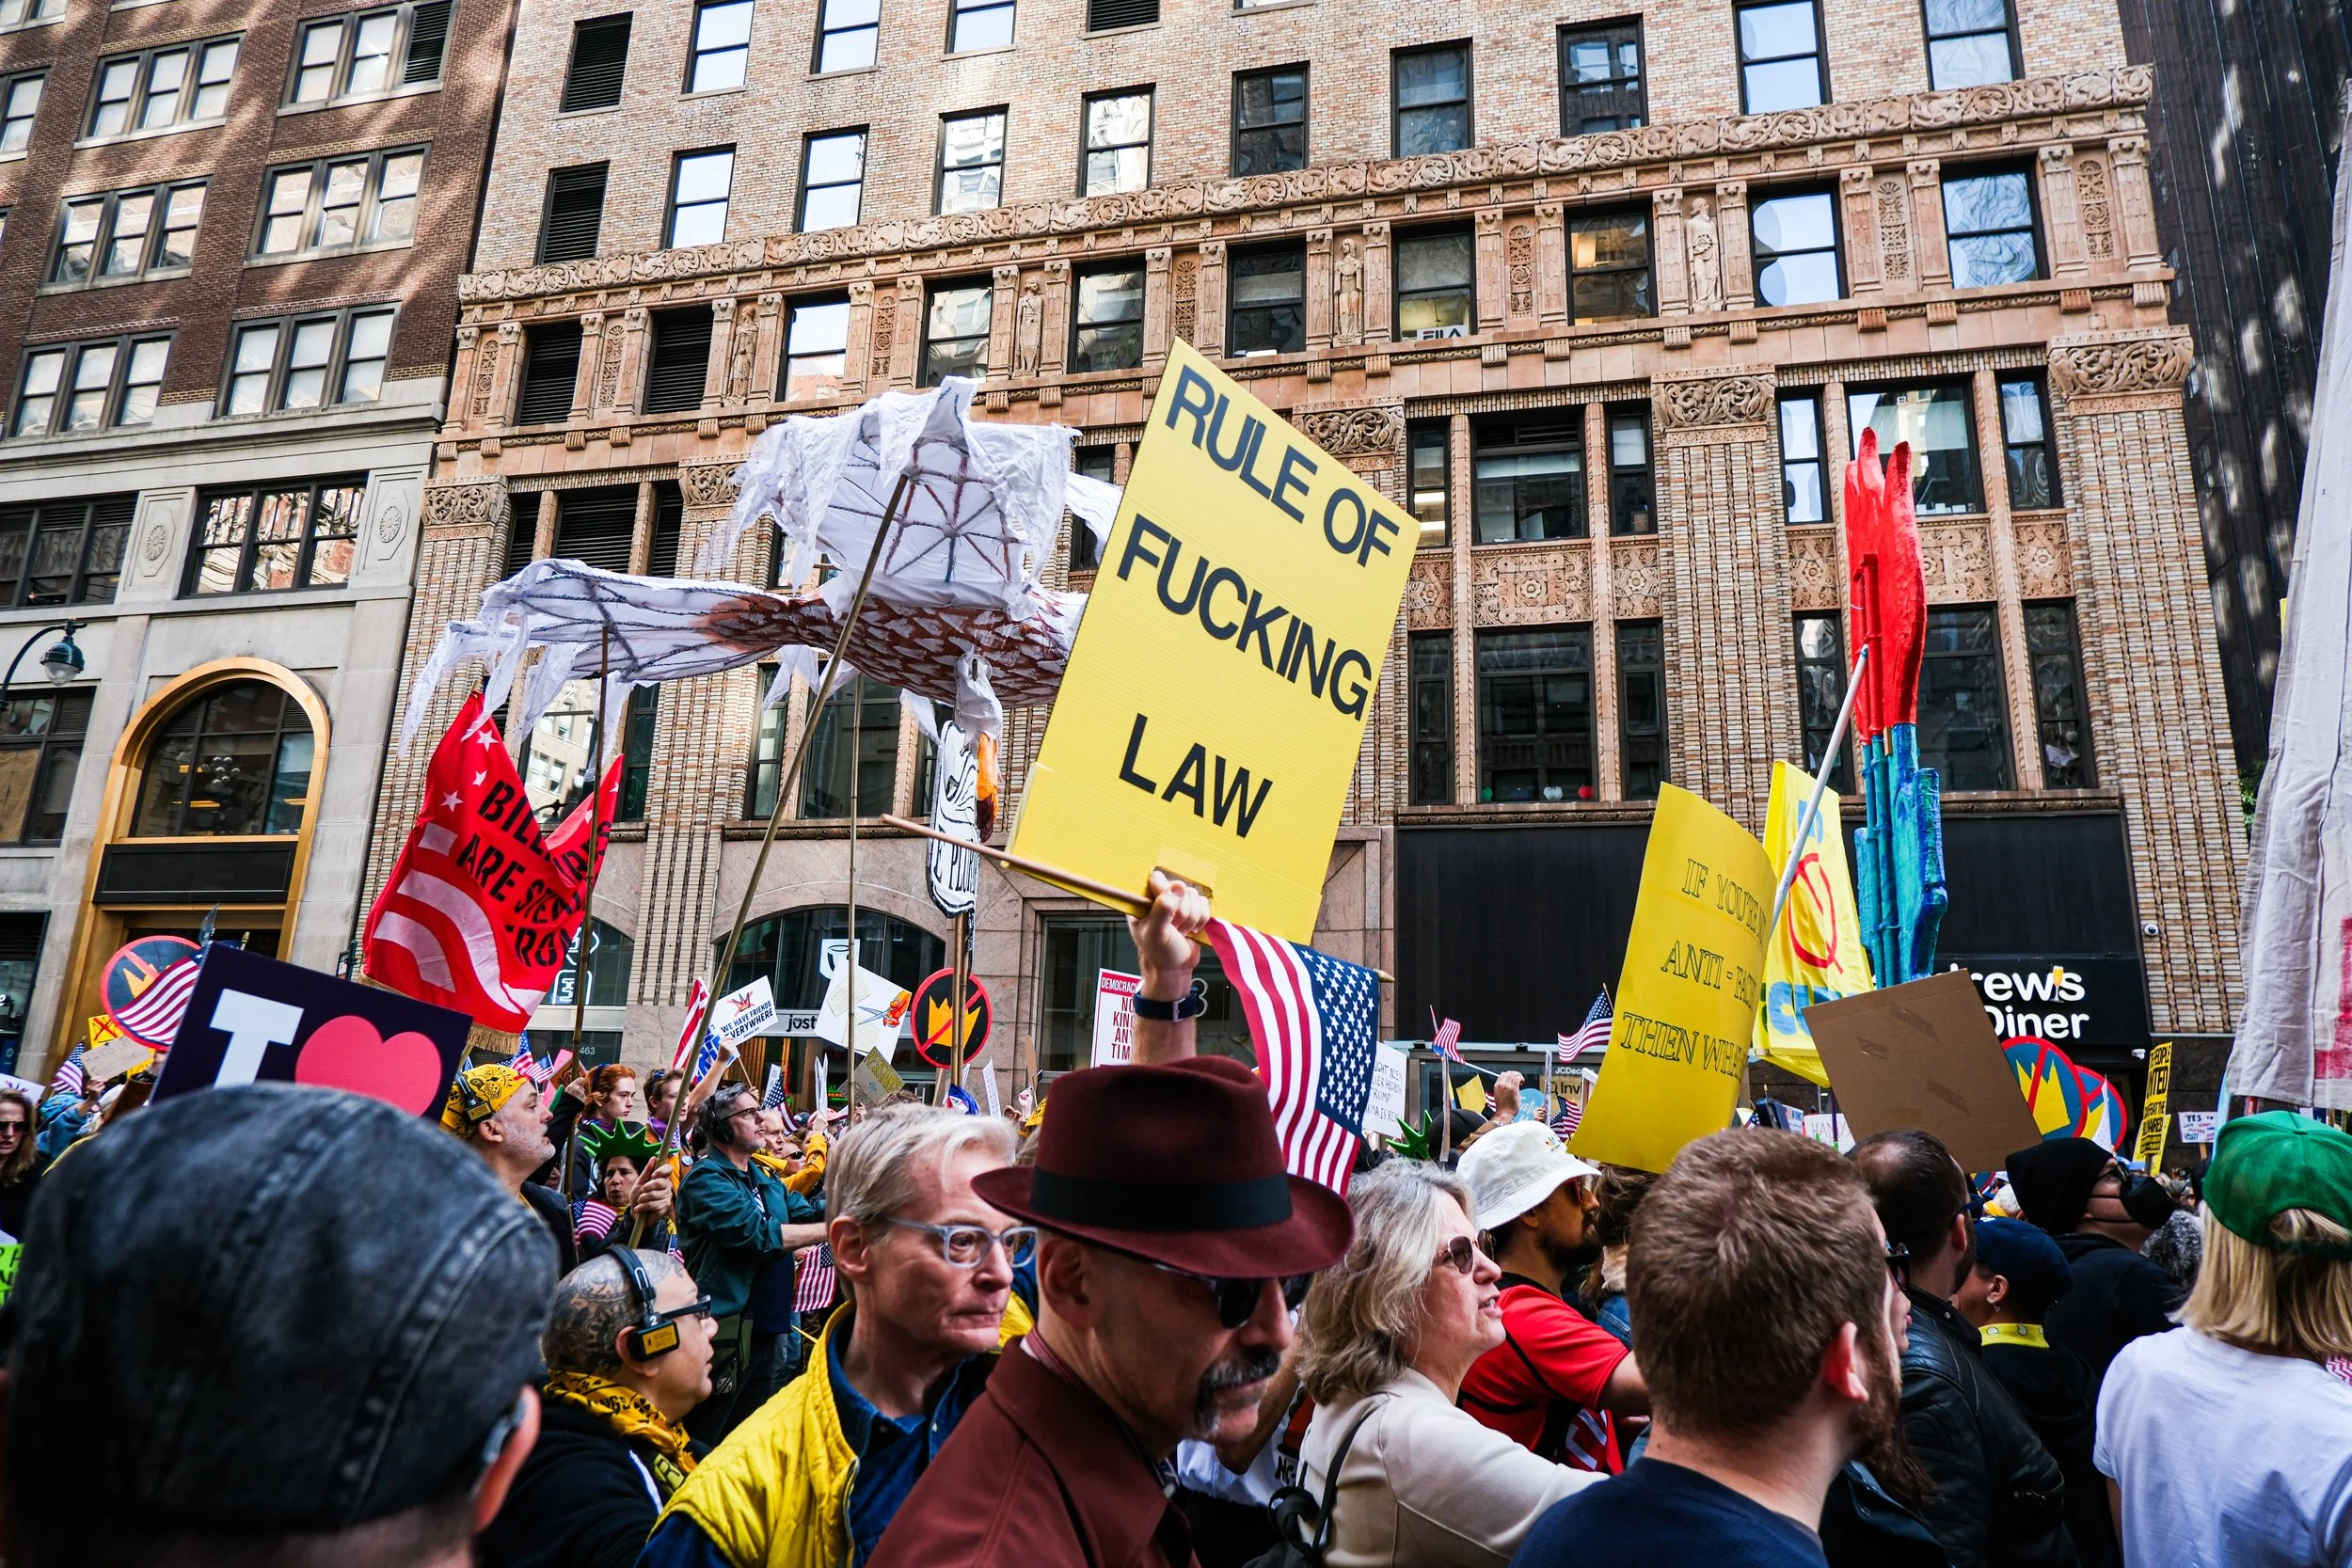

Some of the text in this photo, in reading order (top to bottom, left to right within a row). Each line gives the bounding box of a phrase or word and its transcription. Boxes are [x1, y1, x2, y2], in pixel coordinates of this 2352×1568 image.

[1422, 328, 1462, 341] FILA
[1165, 365, 1399, 567] RULE OF
[1117, 514, 1373, 721] FUCKING
[1119, 713, 1273, 838] LAW
[456, 832, 525, 901] ARE
[1682, 859, 1708, 898] IF
[1102, 977, 1136, 993] DEMOCRAC
[721, 1022, 734, 1034] WE
[734, 1013, 750, 1028] HAVE
[749, 1000, 772, 1018] FRIENDS
[1983, 1005, 2090, 1038] Diner
[580, 1046, 596, 1055] 463
[1620, 1011, 1699, 1065] THEN
[1811, 1121, 1852, 1140] HANDS
[2185, 1114, 2202, 1123] YES
[650, 1315, 659, 1326] 2
